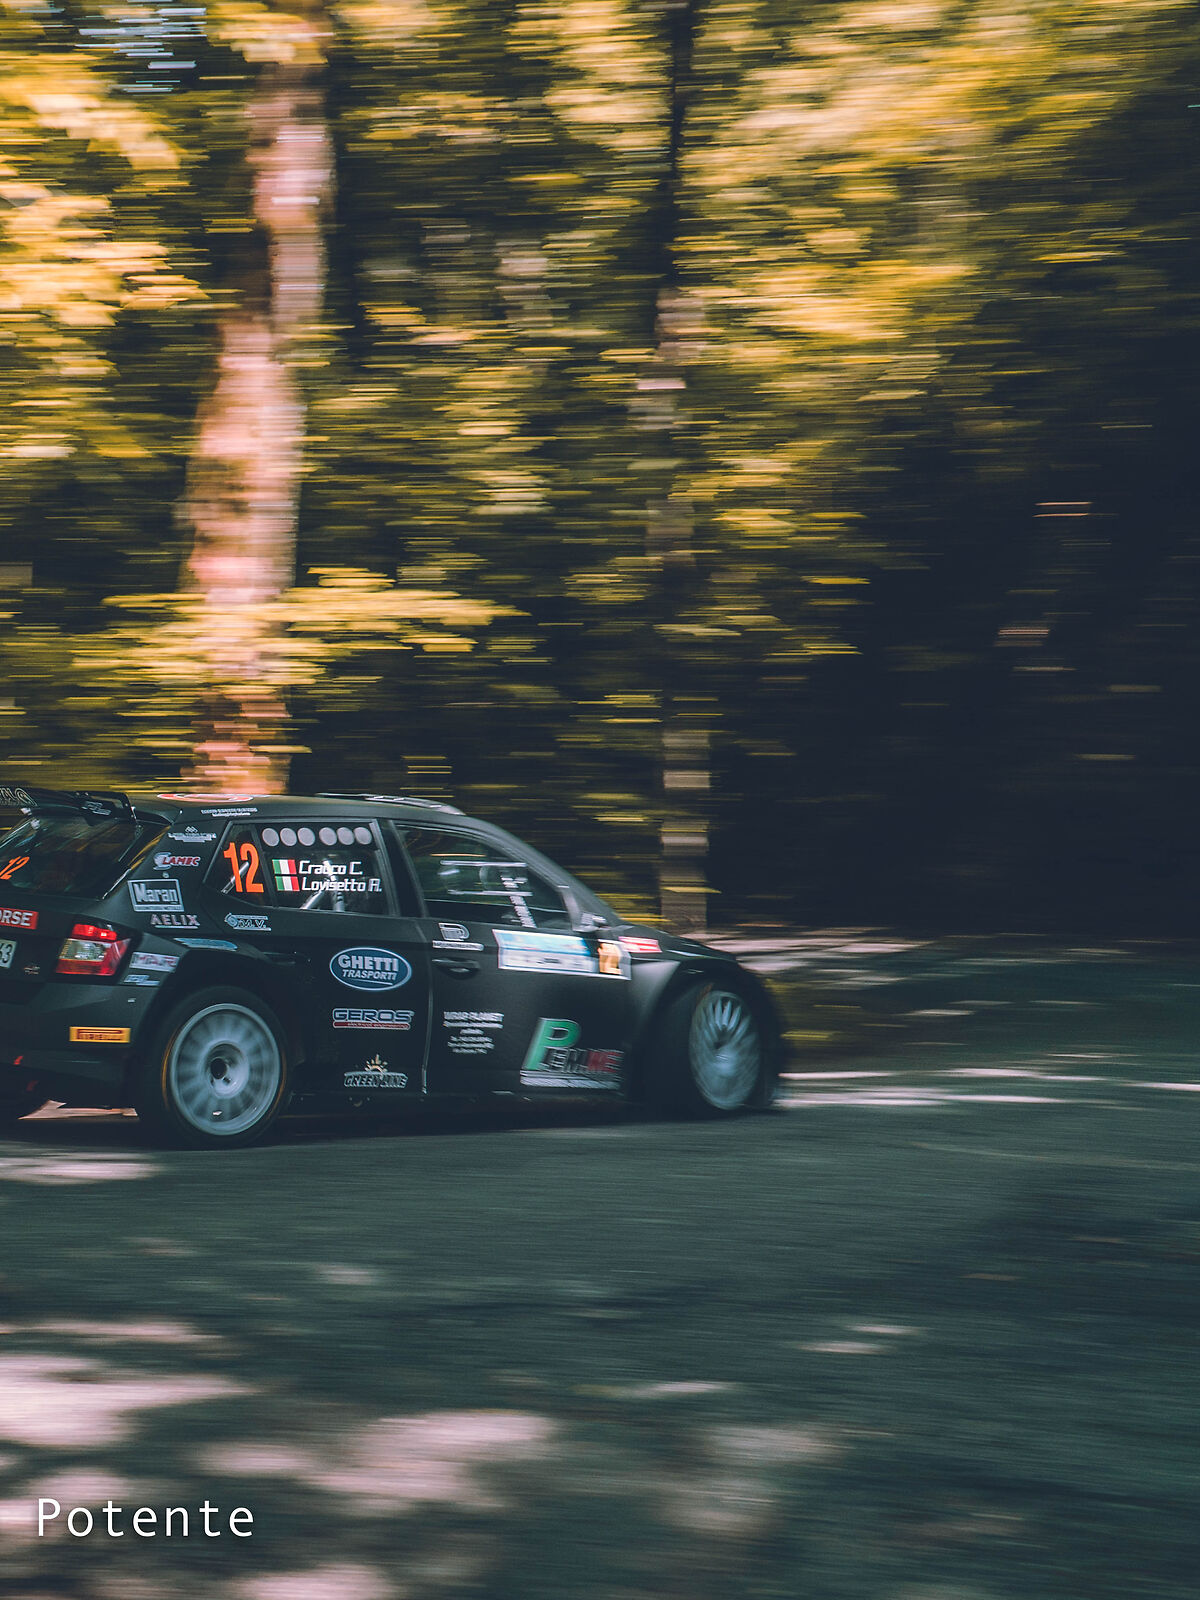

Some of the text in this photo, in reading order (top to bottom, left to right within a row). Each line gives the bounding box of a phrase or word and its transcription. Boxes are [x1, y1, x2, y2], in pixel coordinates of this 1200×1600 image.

[223, 842, 264, 893] 12
[349, 861, 363, 875] C.
[301, 875, 366, 892] Lovisetto
[338, 954, 399, 972] GHETTI
[342, 969, 397, 981] TRASPORTI
[333, 1008, 414, 1023] GEROS
